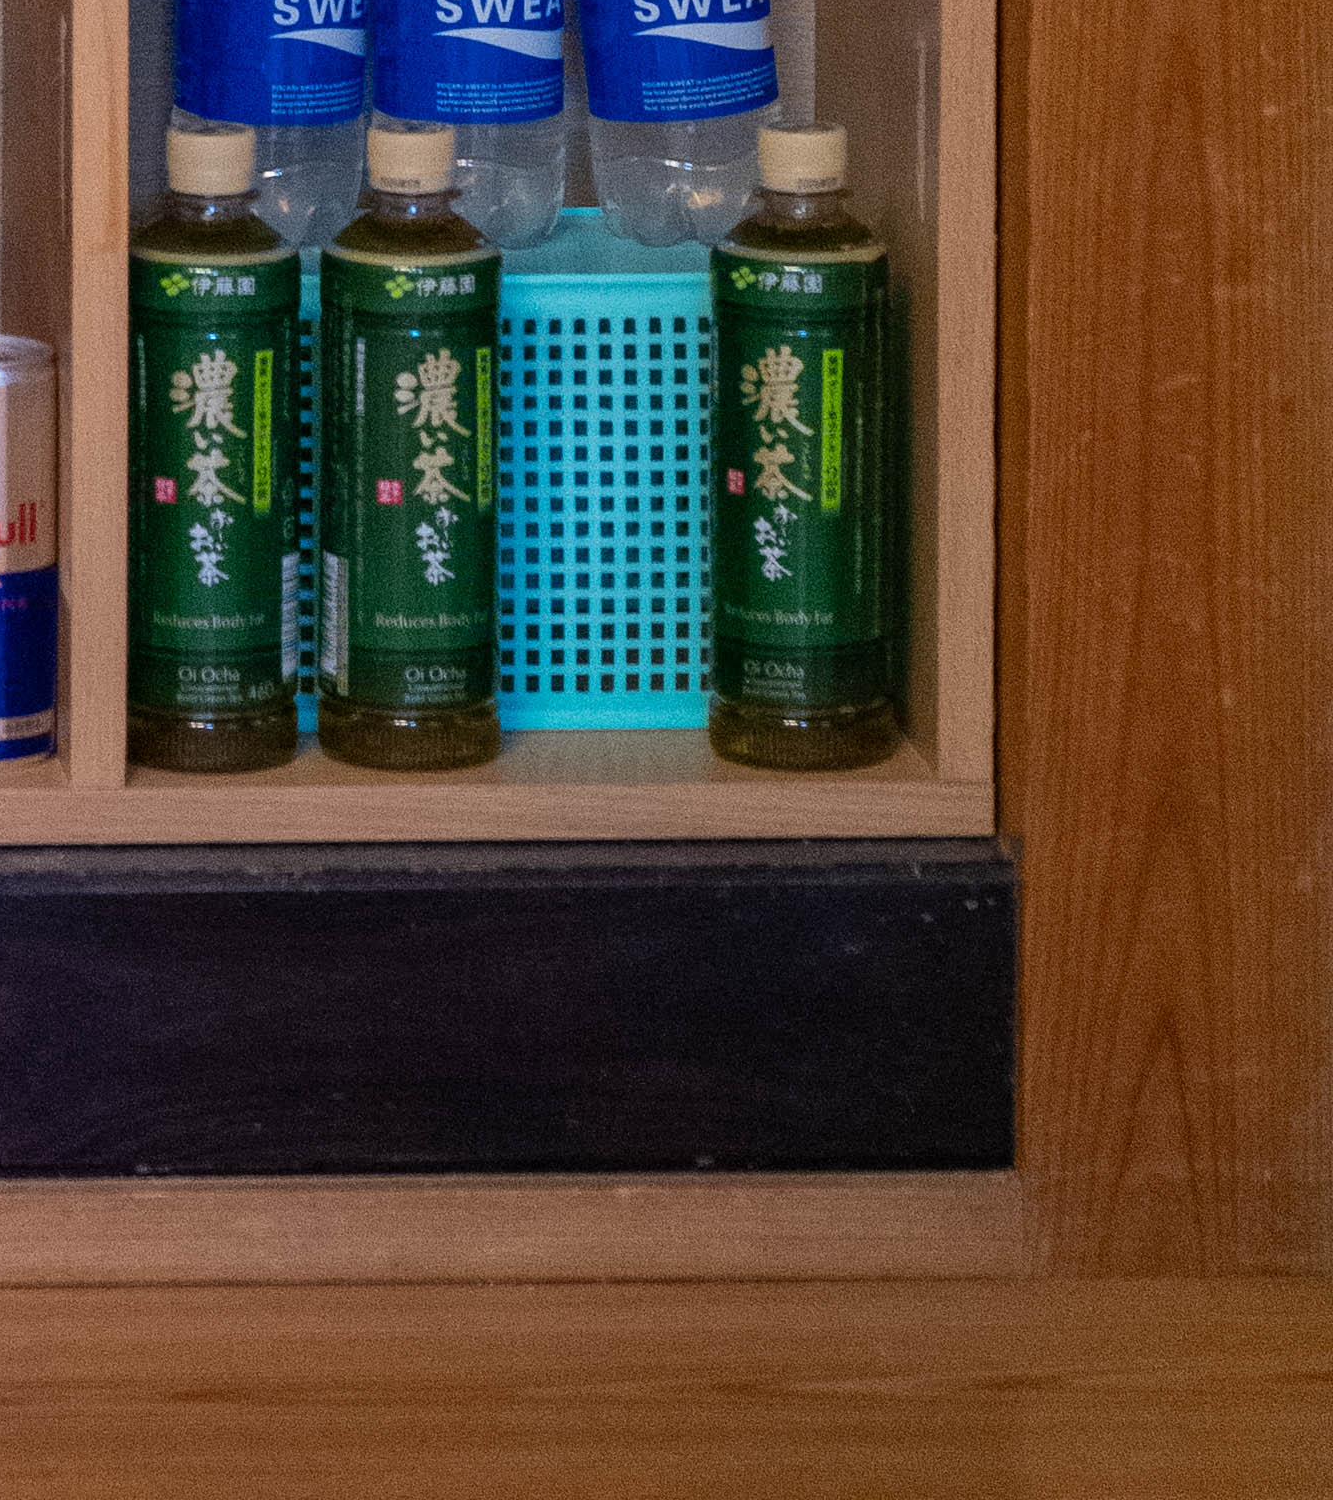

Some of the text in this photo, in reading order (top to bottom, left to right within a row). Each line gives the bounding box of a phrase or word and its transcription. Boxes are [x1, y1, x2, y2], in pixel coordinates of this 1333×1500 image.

[190, 277, 256, 296] 伊藤園
[415, 275, 476, 296] 伊藤園
[171, 348, 247, 507] 濃い茶
[396, 348, 470, 504] 濃い茶
[740, 345, 813, 501] 濃い茶
